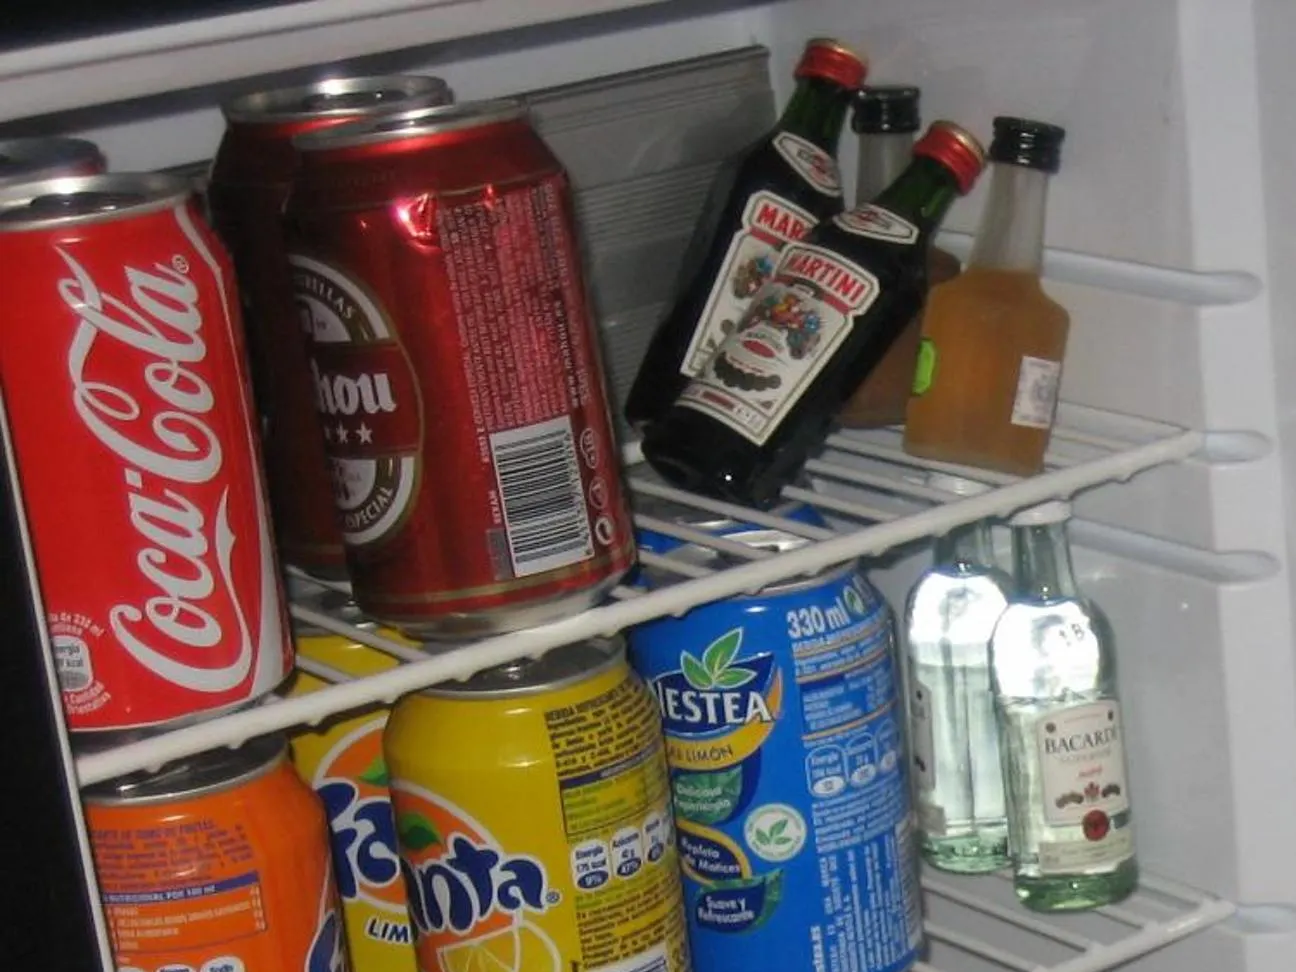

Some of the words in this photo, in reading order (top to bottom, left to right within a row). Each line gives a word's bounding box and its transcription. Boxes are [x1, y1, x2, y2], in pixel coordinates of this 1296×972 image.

[56, 243, 252, 692] Coca-Cola
[787, 606, 825, 639] 330
[1044, 724, 1118, 754] BACARDI
[368, 918, 410, 942] LIM
